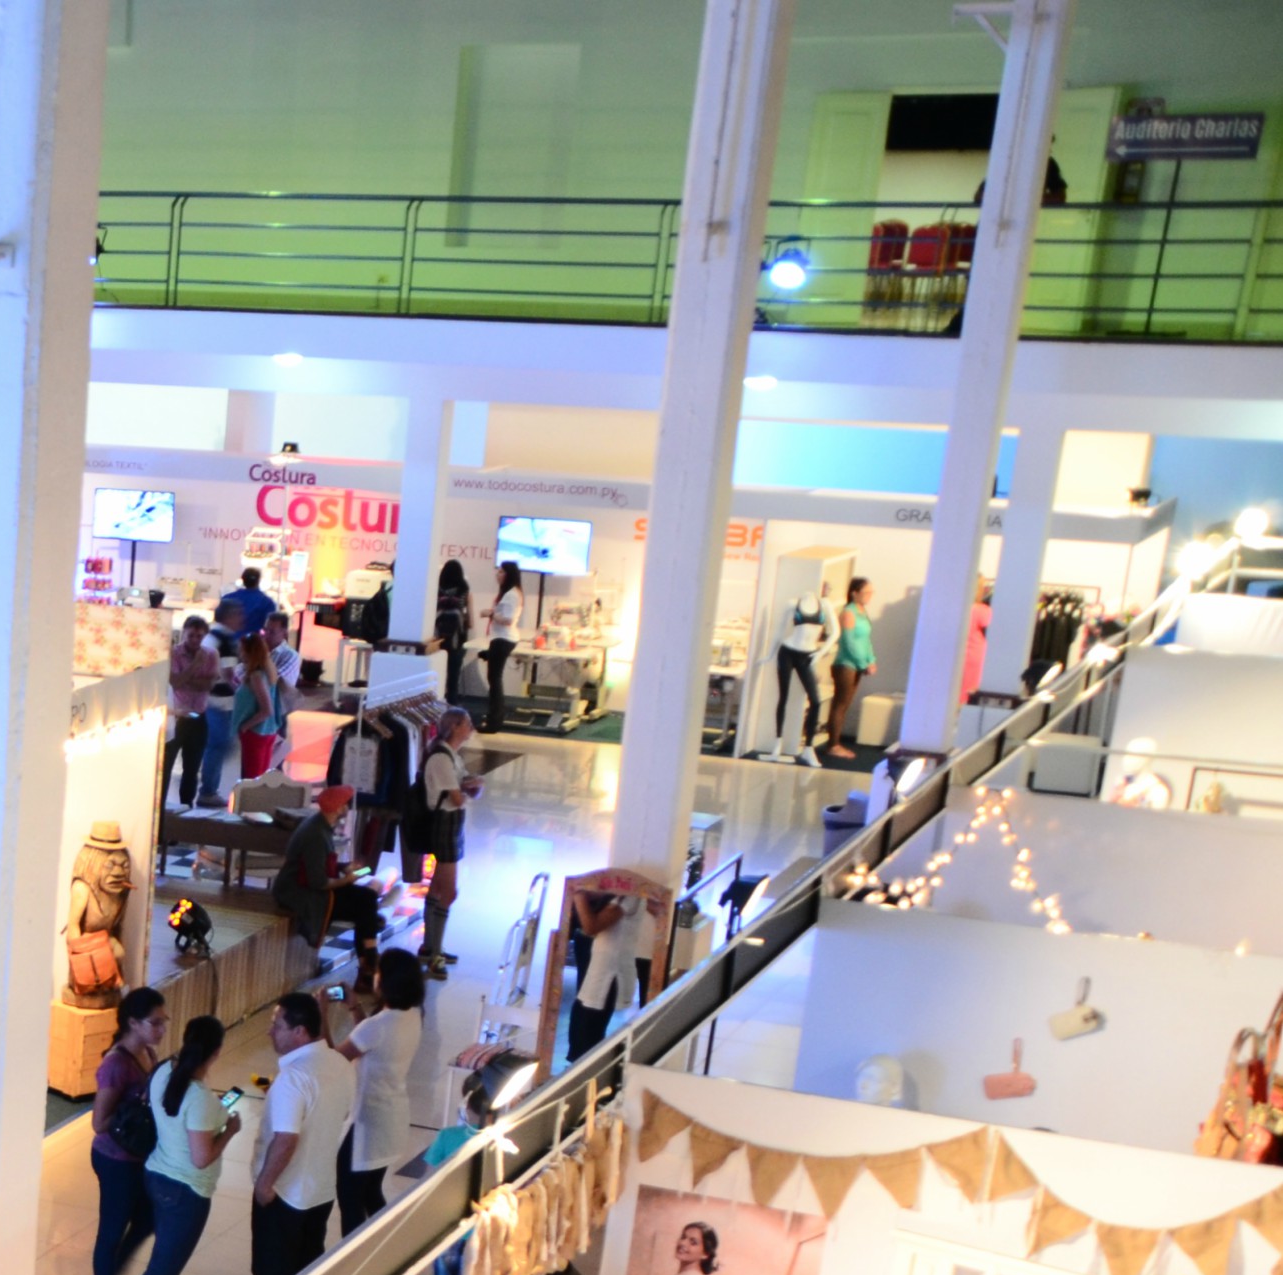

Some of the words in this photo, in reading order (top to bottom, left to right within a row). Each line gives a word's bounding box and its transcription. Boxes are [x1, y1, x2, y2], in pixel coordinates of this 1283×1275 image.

[1114, 118, 1192, 140] Auditorio
[1194, 118, 1259, 139] Charlas
[248, 463, 317, 486] Costura
